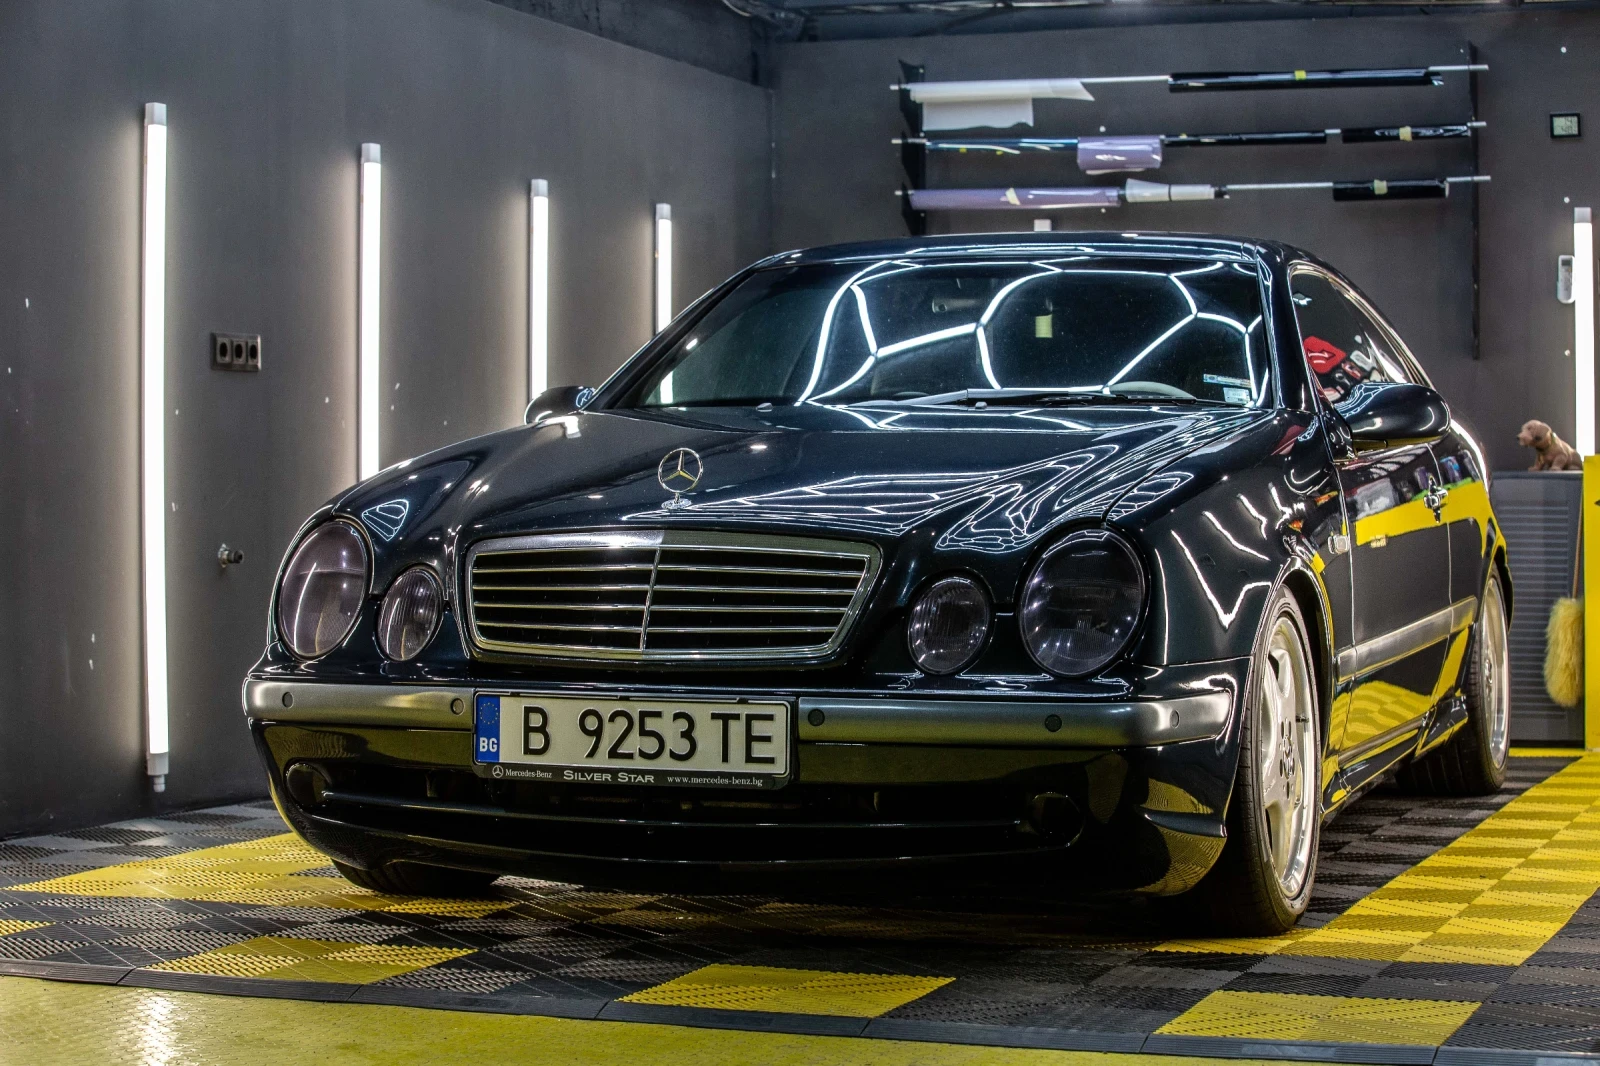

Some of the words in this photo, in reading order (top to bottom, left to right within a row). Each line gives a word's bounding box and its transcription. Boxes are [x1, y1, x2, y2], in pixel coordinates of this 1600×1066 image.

[522, 705, 550, 756] B
[578, 707, 698, 762] 9253
[710, 711, 776, 765] TE
[479, 737, 498, 752] BG
[505, 768, 553, 779] Mercedes-Benz
[667, 776, 764, 787] www.mercedes-benz.bg
